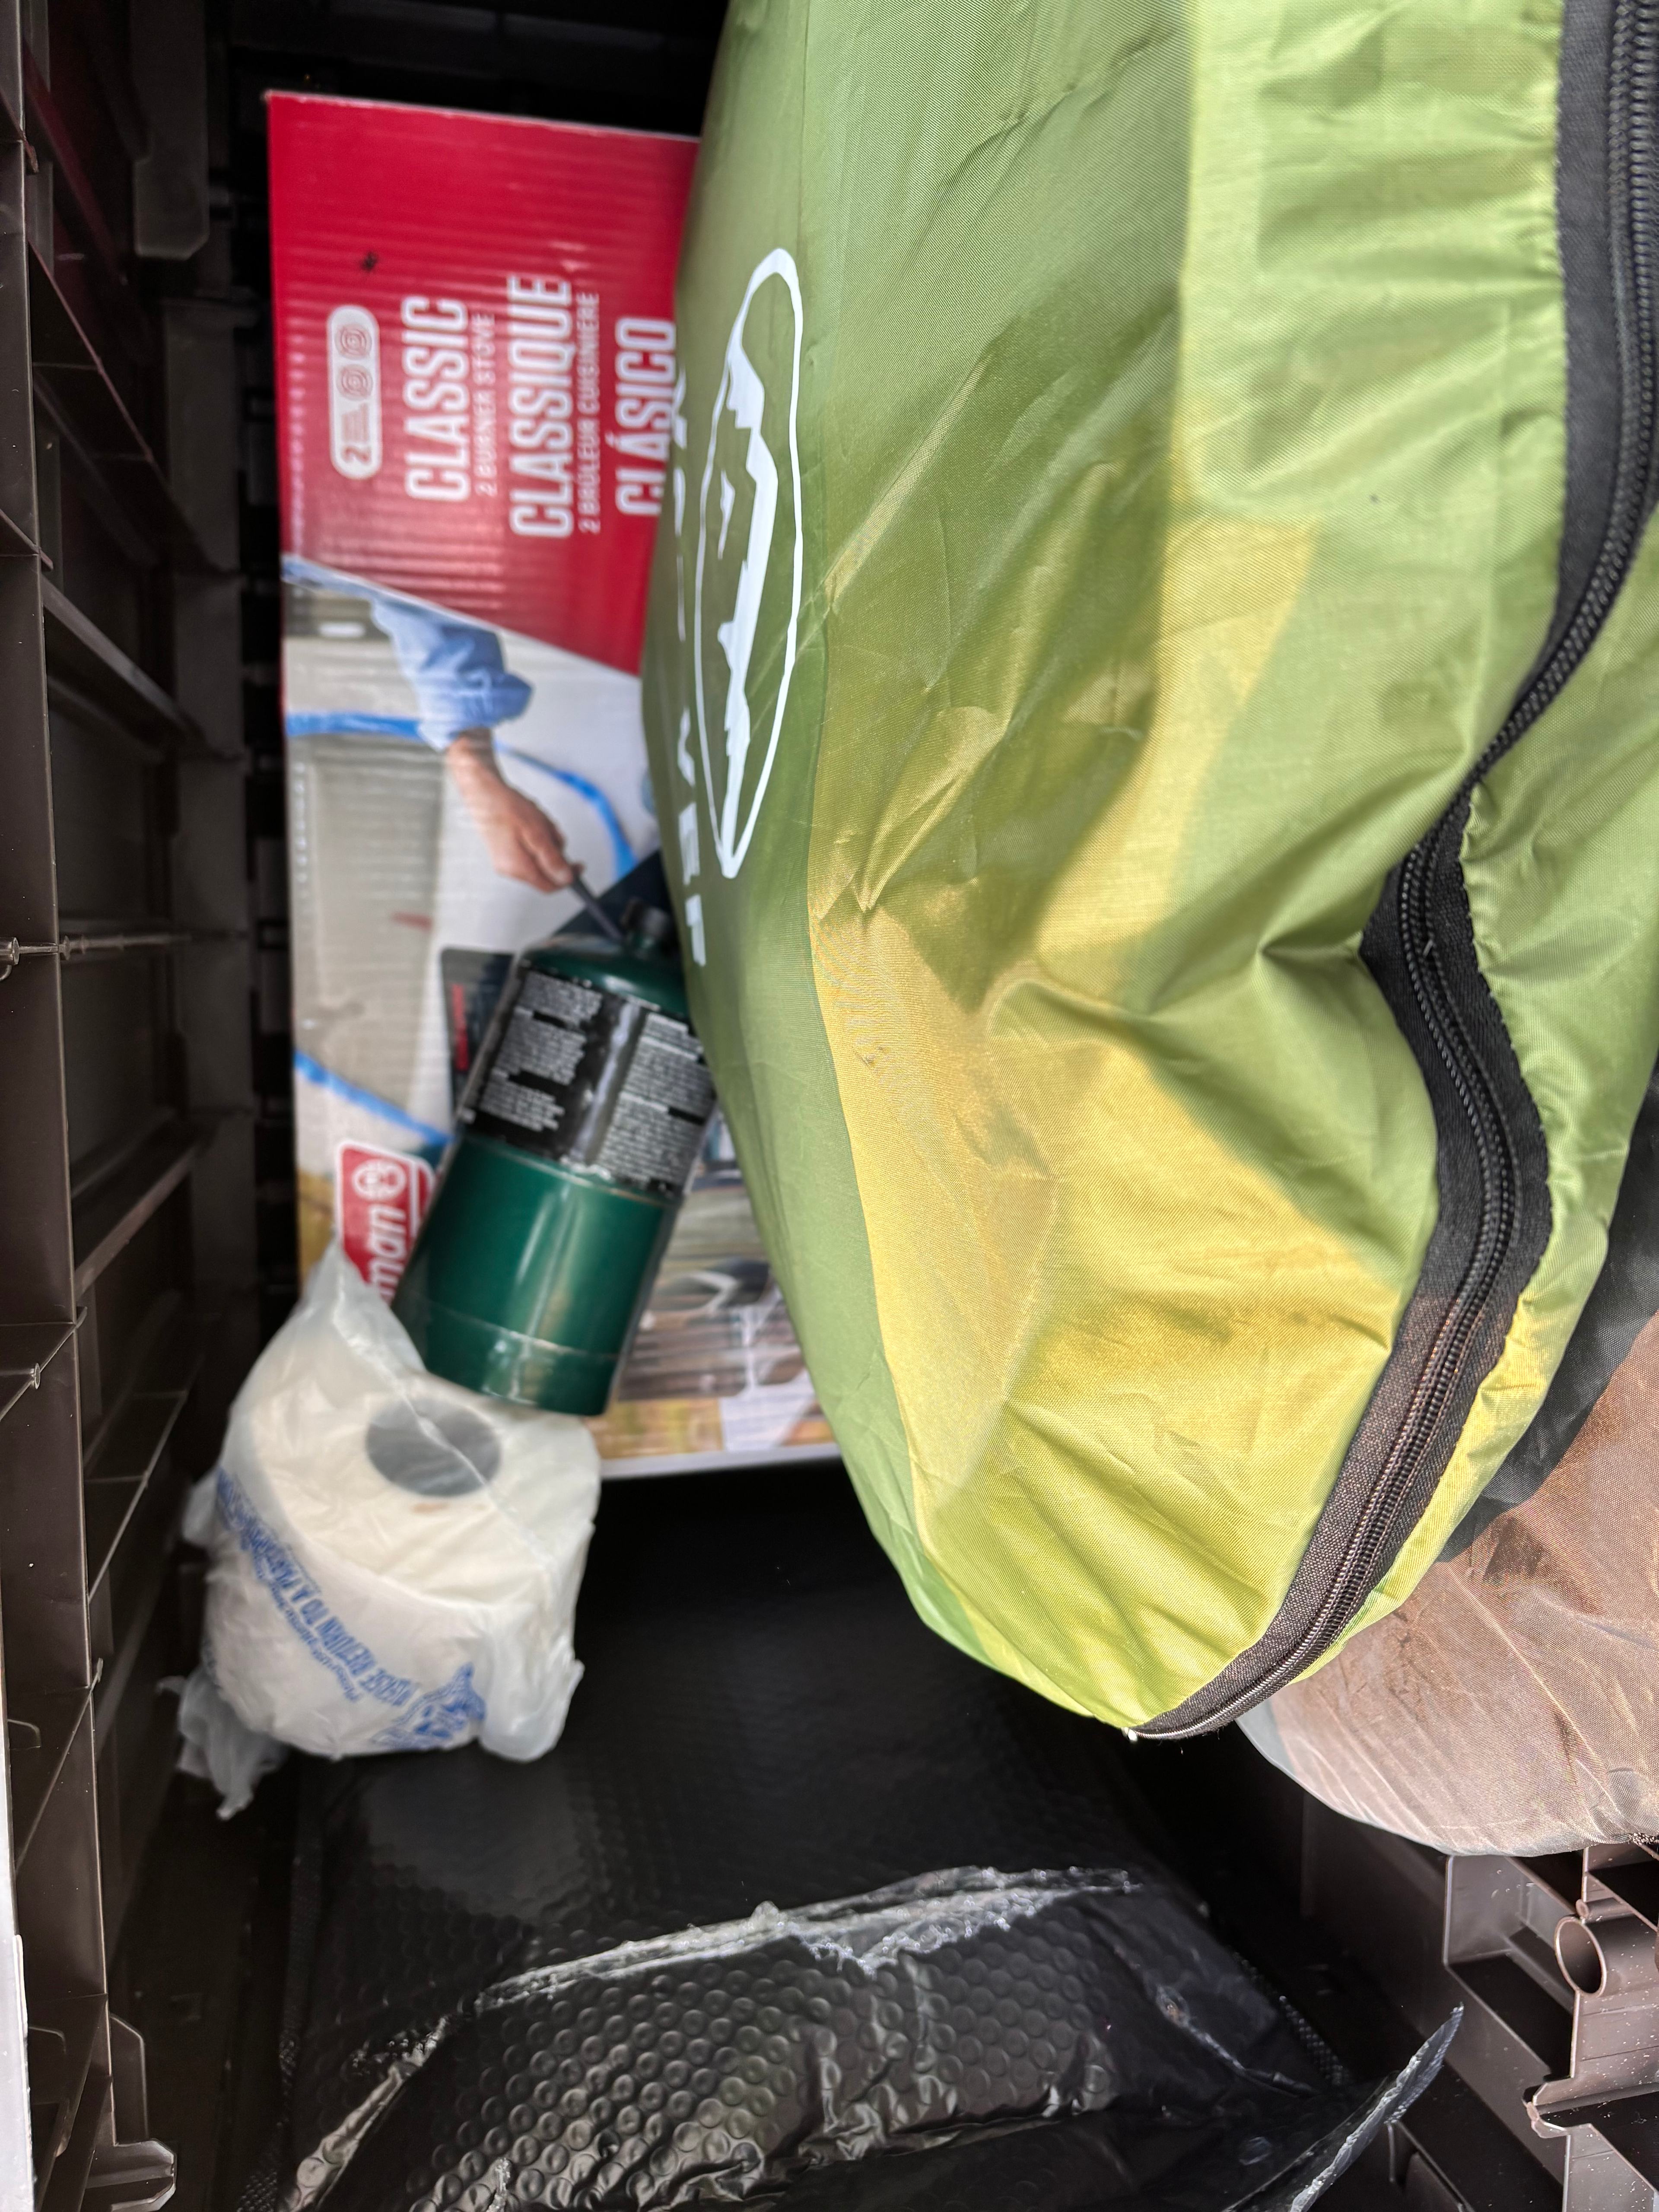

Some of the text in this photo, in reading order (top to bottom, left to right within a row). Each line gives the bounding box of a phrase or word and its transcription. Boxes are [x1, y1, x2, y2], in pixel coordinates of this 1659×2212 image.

[403, 297, 470, 500] CLASSIC
[471, 312, 497, 497] 2 BURNER STOVE
[509, 274, 576, 537] CLASSIQUE
[578, 518, 601, 534] 2
